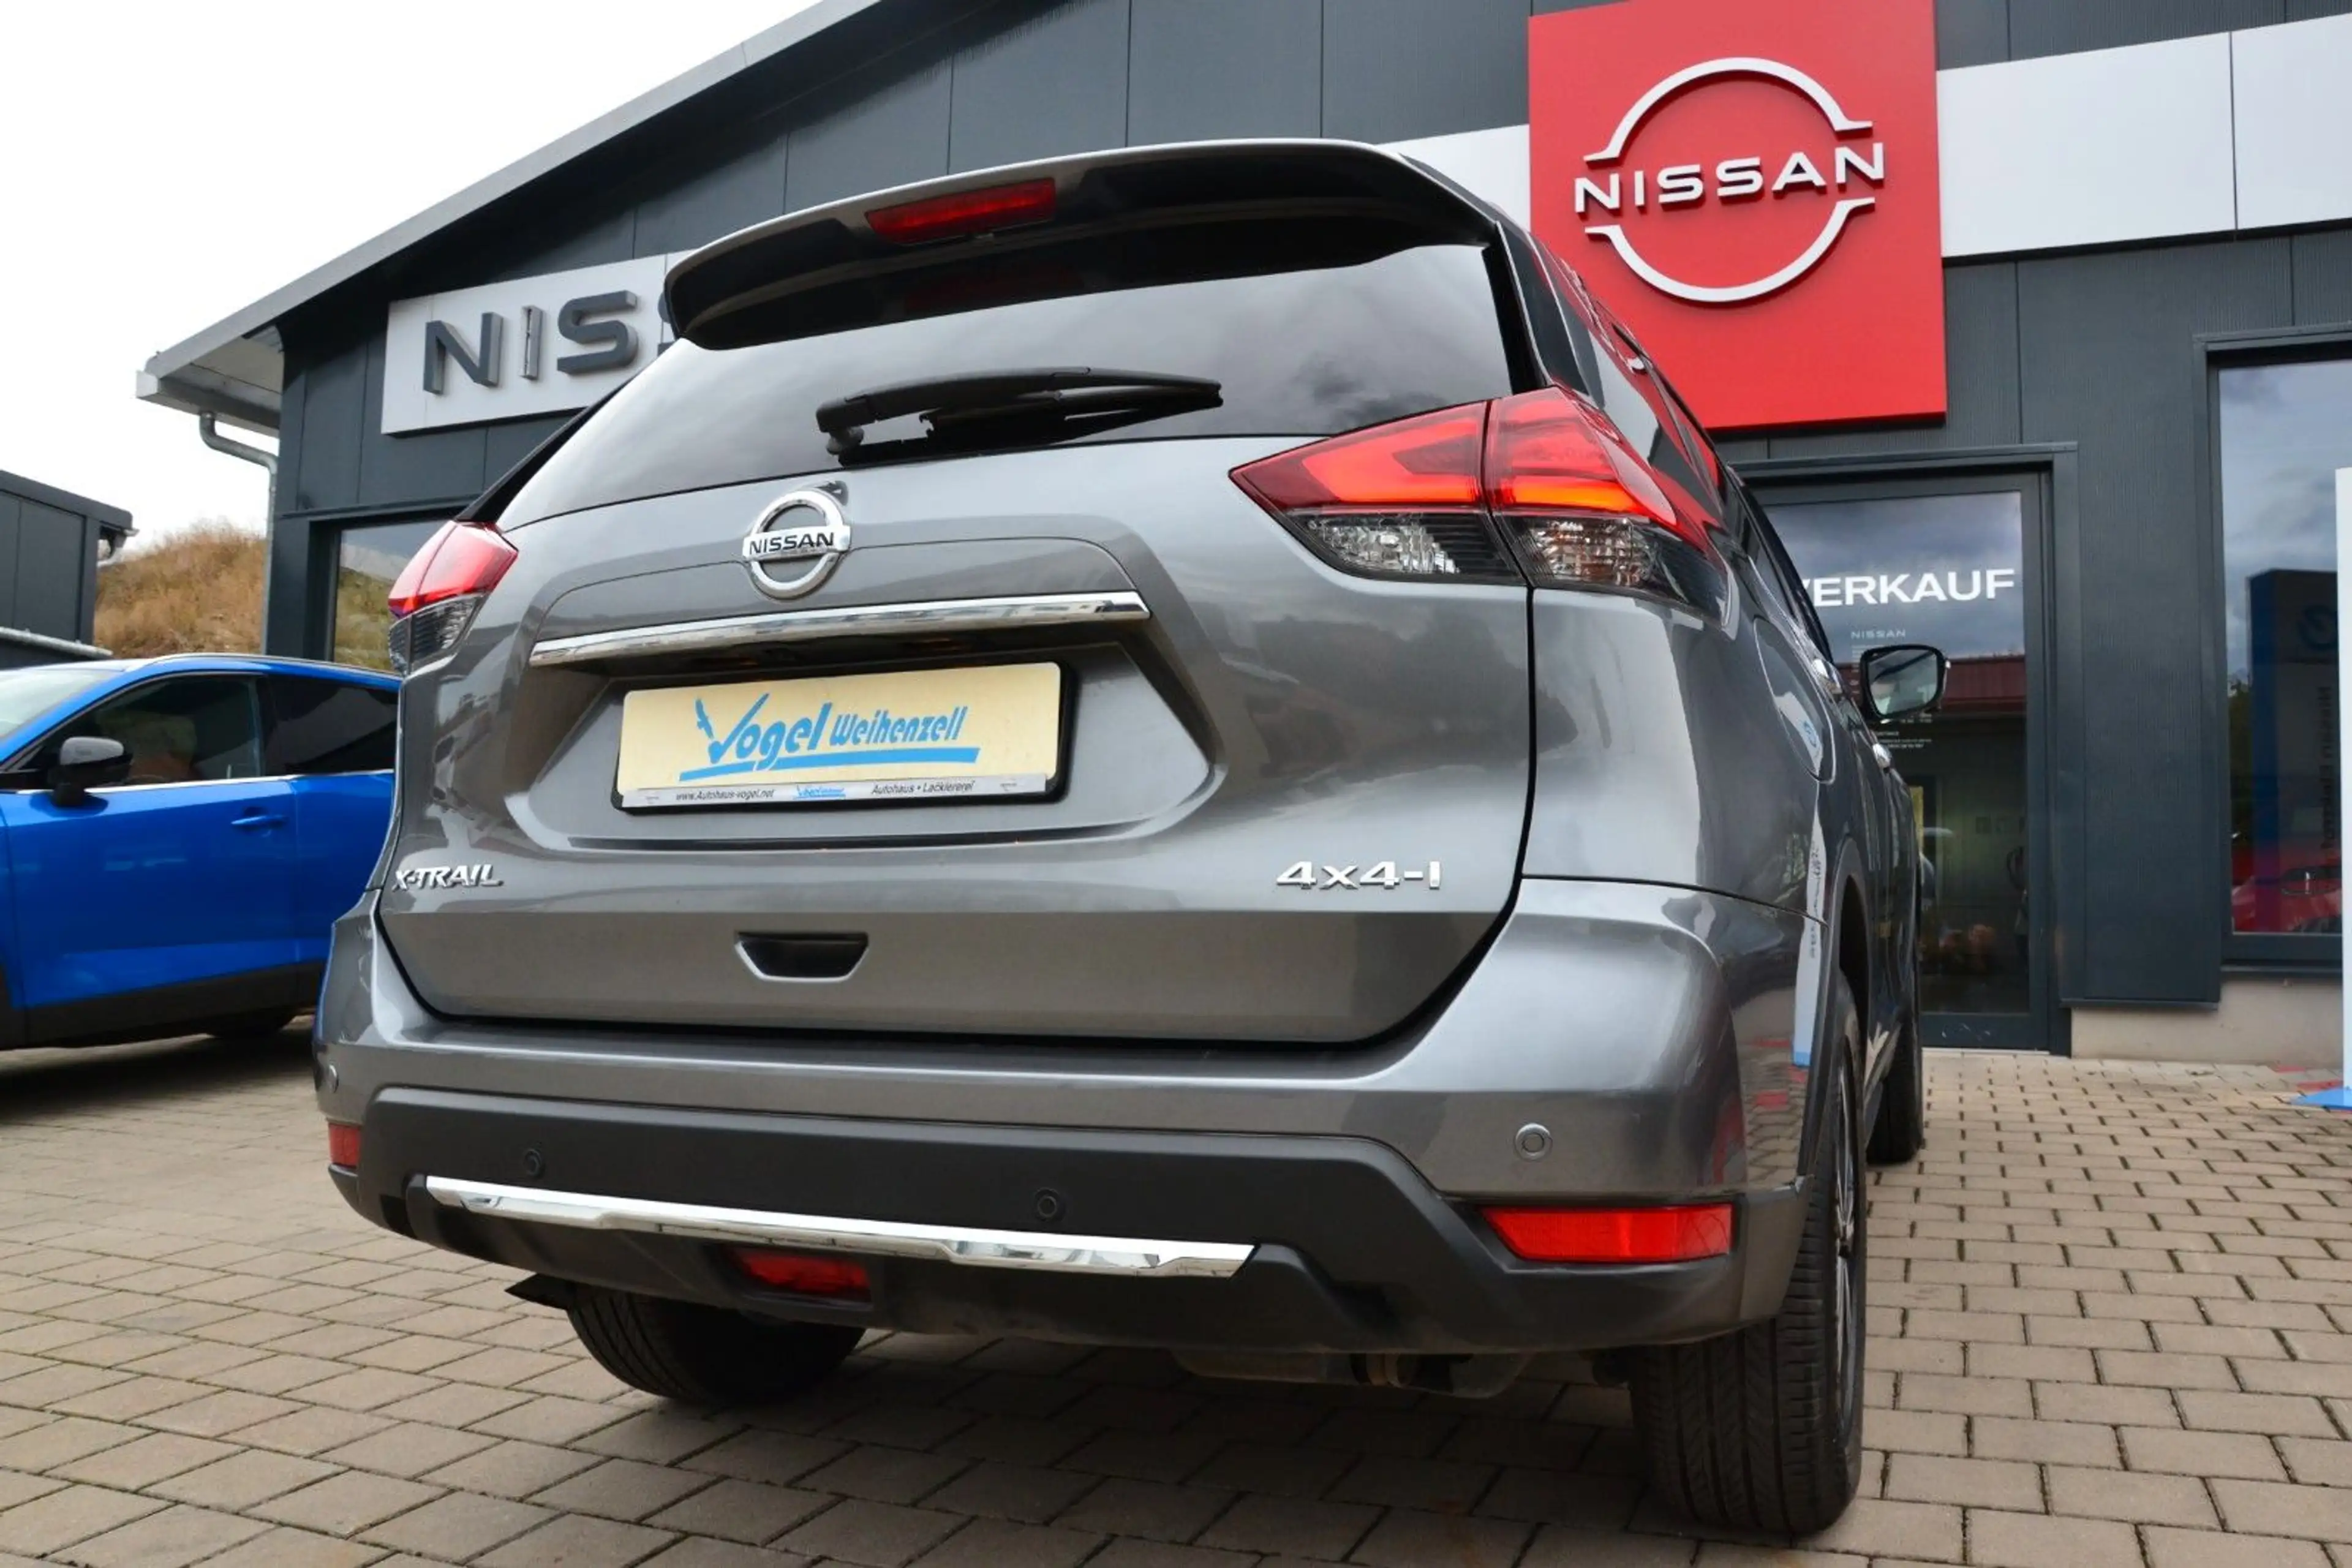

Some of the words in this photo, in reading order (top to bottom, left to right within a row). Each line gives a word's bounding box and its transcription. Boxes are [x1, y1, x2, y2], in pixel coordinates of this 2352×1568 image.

[1574, 142, 1885, 213] NISSAN
[423, 289, 676, 395] NIS
[749, 532, 834, 555] NISSAN
[1803, 568, 2015, 608] ERKAUF
[1851, 629, 1906, 639] NISSAN
[695, 693, 833, 771] Vogel
[829, 706, 968, 747] Weihenzell
[872, 782, 914, 795] Autohaus
[391, 864, 505, 892] X-TRAIL
